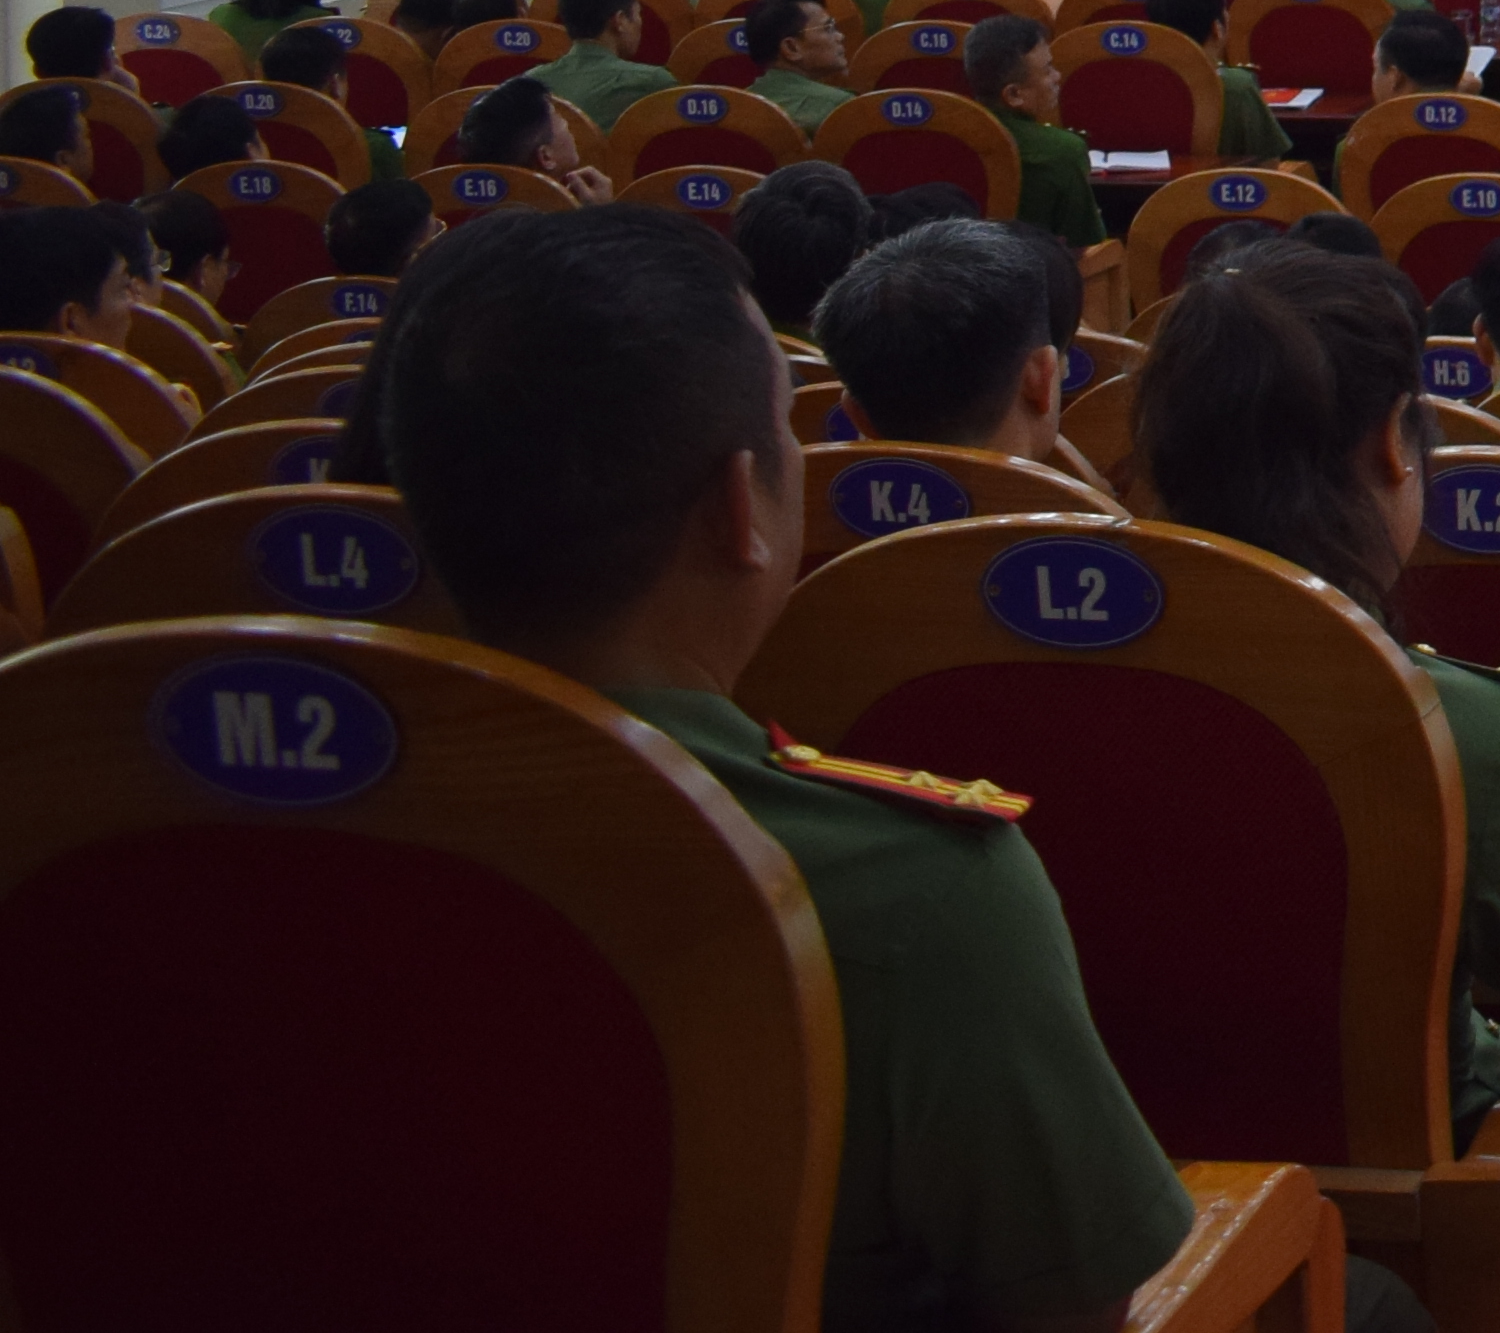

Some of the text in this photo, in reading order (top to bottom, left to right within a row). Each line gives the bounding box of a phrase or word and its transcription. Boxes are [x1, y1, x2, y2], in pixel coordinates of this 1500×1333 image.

[240, 176, 270, 194] E.18
[1221, 184, 1254, 202] E.12
[1462, 189, 1496, 208] E.10
[345, 292, 377, 312] F.14
[1434, 360, 1470, 386] H.6
[870, 480, 929, 523] K.4
[301, 533, 368, 588] L.4
[1037, 566, 1108, 620] L.2
[214, 692, 339, 769] M.2
